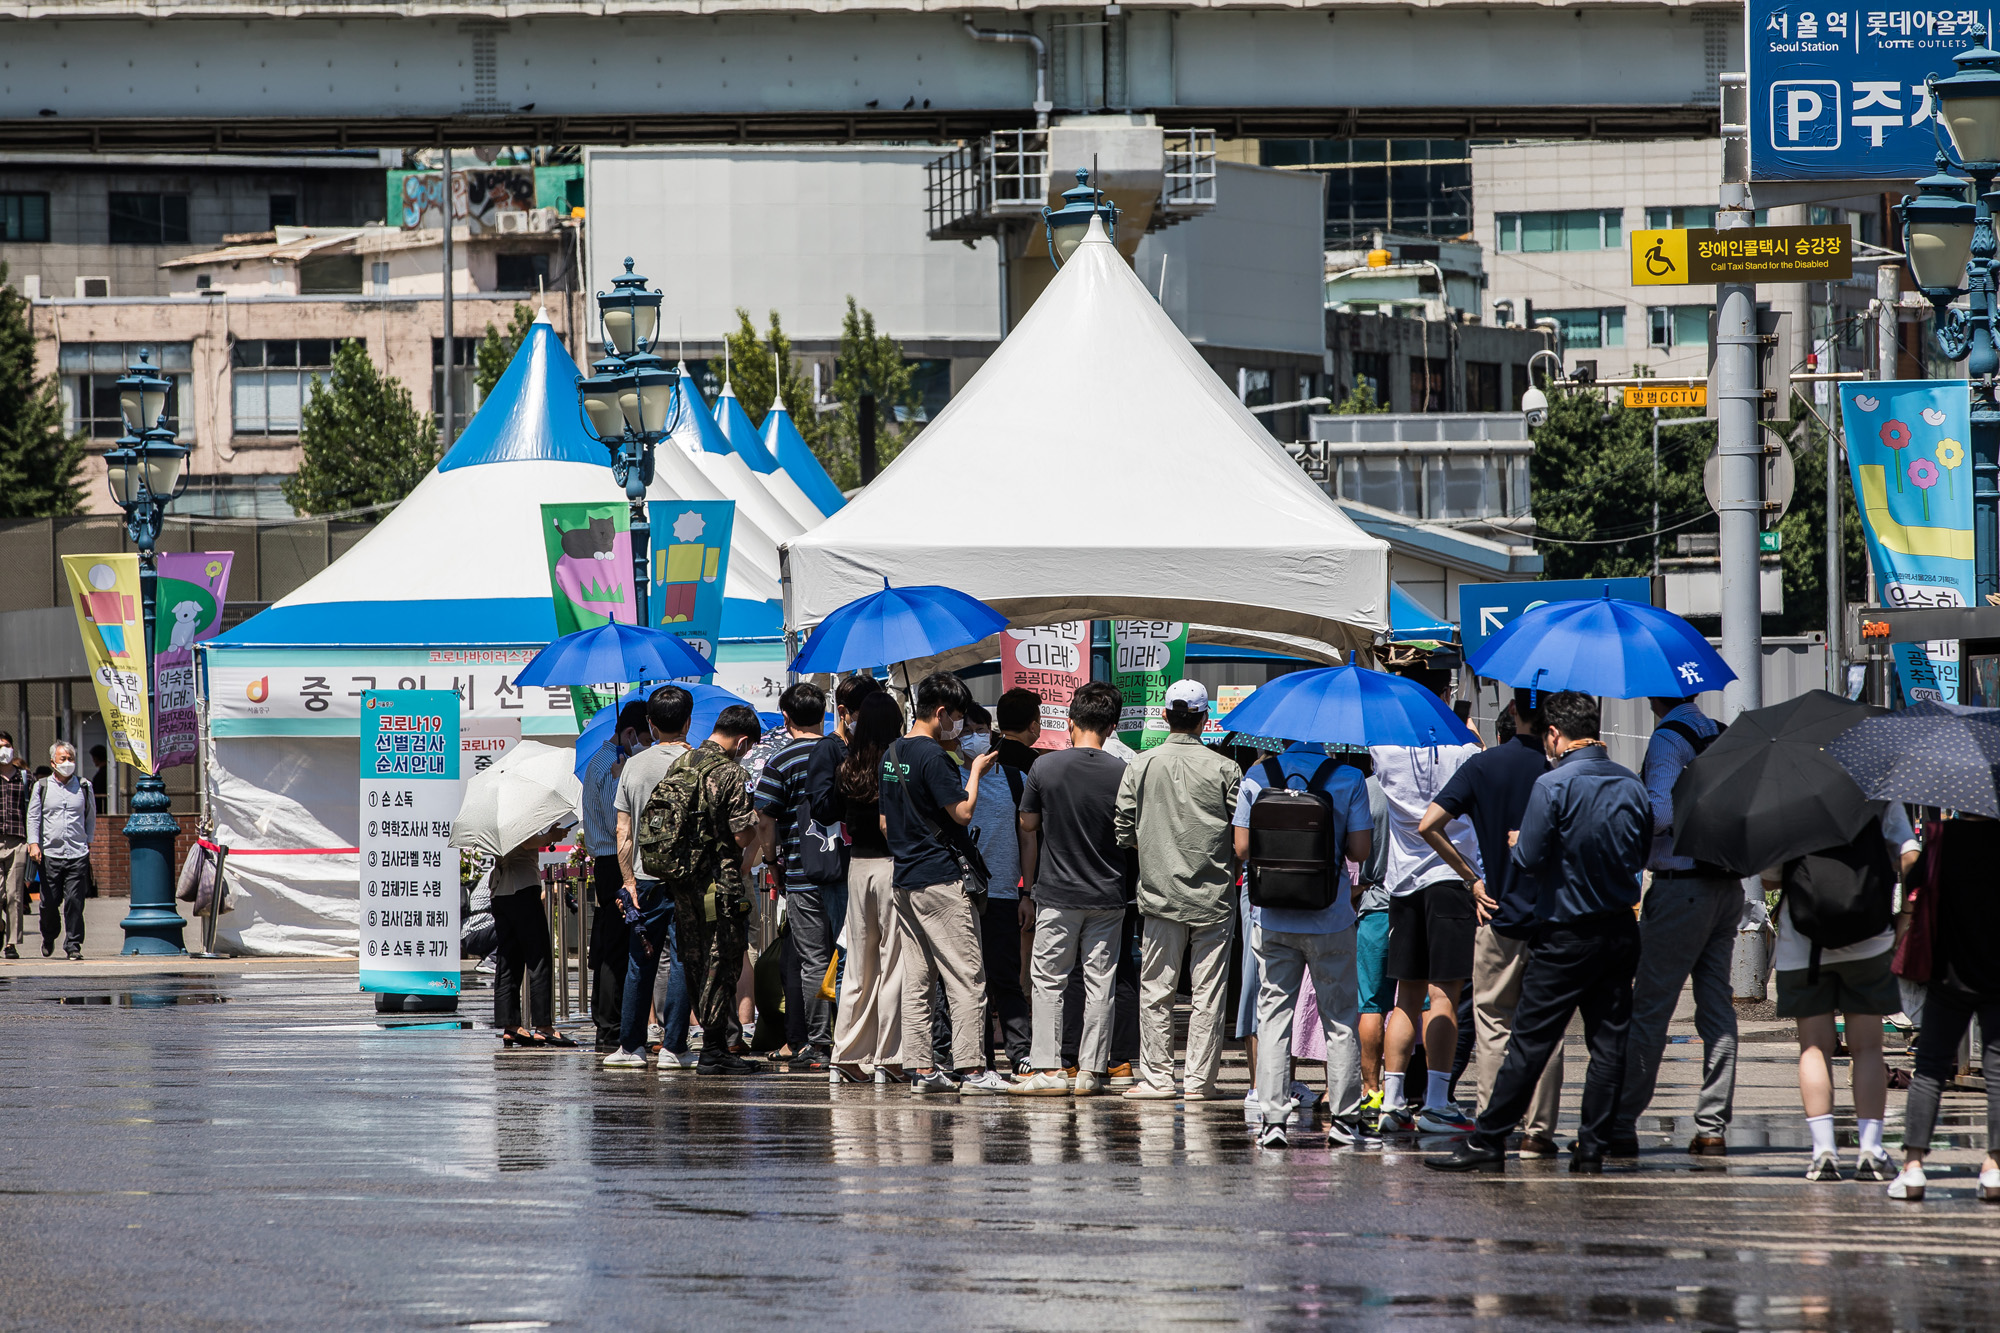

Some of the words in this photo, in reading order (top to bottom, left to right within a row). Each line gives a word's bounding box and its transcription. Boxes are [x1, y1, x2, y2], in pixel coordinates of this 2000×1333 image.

[1866, 10, 1979, 37] 롯데아울렛
[1769, 41, 1799, 52] Seoul
[1801, 41, 1839, 51] Station
[1878, 40, 1914, 49] LOTTE
[1918, 39, 1967, 48] OUTLETS
[1787, 90, 1823, 141] P
[1698, 238, 1789, 258] 장애인콜택시
[1794, 237, 1841, 255] 승강장
[1711, 262, 1726, 271] Call
[1728, 262, 1743, 271] Taxi
[1745, 261, 1767, 270] Stand
[1769, 261, 1779, 269] for
[1781, 261, 1793, 269] the
[1795, 259, 1829, 269] Disabled
[1027, 643, 1073, 668] 미래:
[1120, 645, 1161, 668] 미래:
[1014, 671, 1083, 689] 공공디자인이
[161, 689, 190, 709] 미래:
[379, 715, 442, 732] 코로나19
[375, 734, 445, 752] 선별검사
[461, 739, 506, 751] 코로나19
[376, 755, 444, 773] 순서안내
[381, 790, 391, 808] 손
[394, 790, 413, 808] 소독
[381, 820, 428, 838] 역학조사서
[431, 821, 450, 838] 작성
[381, 850, 419, 867] 검사라벨
[422, 850, 441, 868] 작성
[380, 880, 419, 897] 검체키트
[422, 880, 441, 898] 수령
[380, 910, 423, 927] 검사(검체
[426, 910, 449, 927] 채취)
[380, 940, 390, 957] 손
[393, 940, 412, 957] 소독
[415, 940, 425, 957] 후
[428, 940, 448, 957] 귀가
